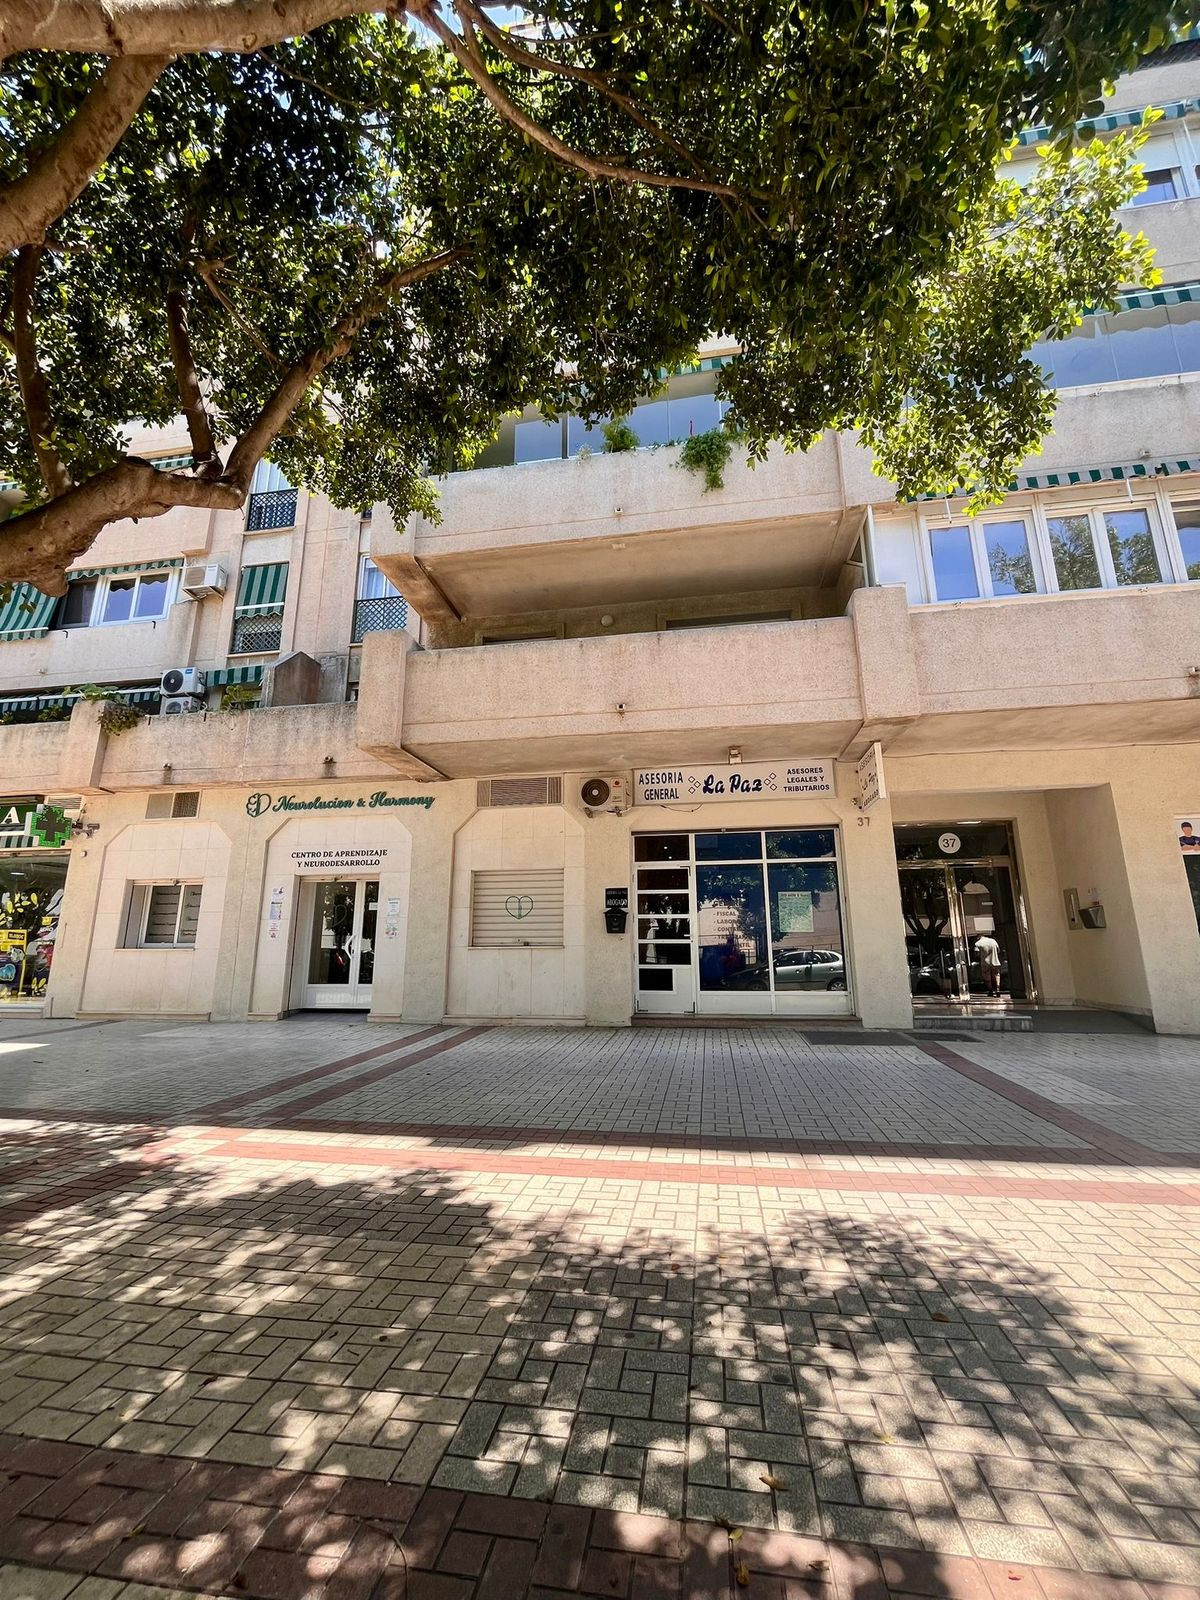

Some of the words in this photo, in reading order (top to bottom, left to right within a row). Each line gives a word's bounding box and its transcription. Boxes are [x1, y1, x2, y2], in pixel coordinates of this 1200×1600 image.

[787, 767, 823, 775] ASESORES
[638, 772, 683, 785] ASESORIA
[786, 776, 818, 784] LEGALES
[702, 774, 725, 795] La
[729, 773, 763, 794] Paz
[783, 784, 830, 793] TRIBUTARIOS
[644, 787, 680, 800] GENERAL
[272, 795, 353, 812] Neurolucion
[356, 798, 366, 808] &
[368, 791, 436, 810] Harmony
[857, 817, 870, 827] 37
[942, 838, 956, 848] 37
[291, 850, 322, 859] CENTRO
[323, 850, 334, 858] DE
[334, 849, 388, 858] APRENDIZAJE
[303, 859, 380, 868] NEURODESARROLLO
